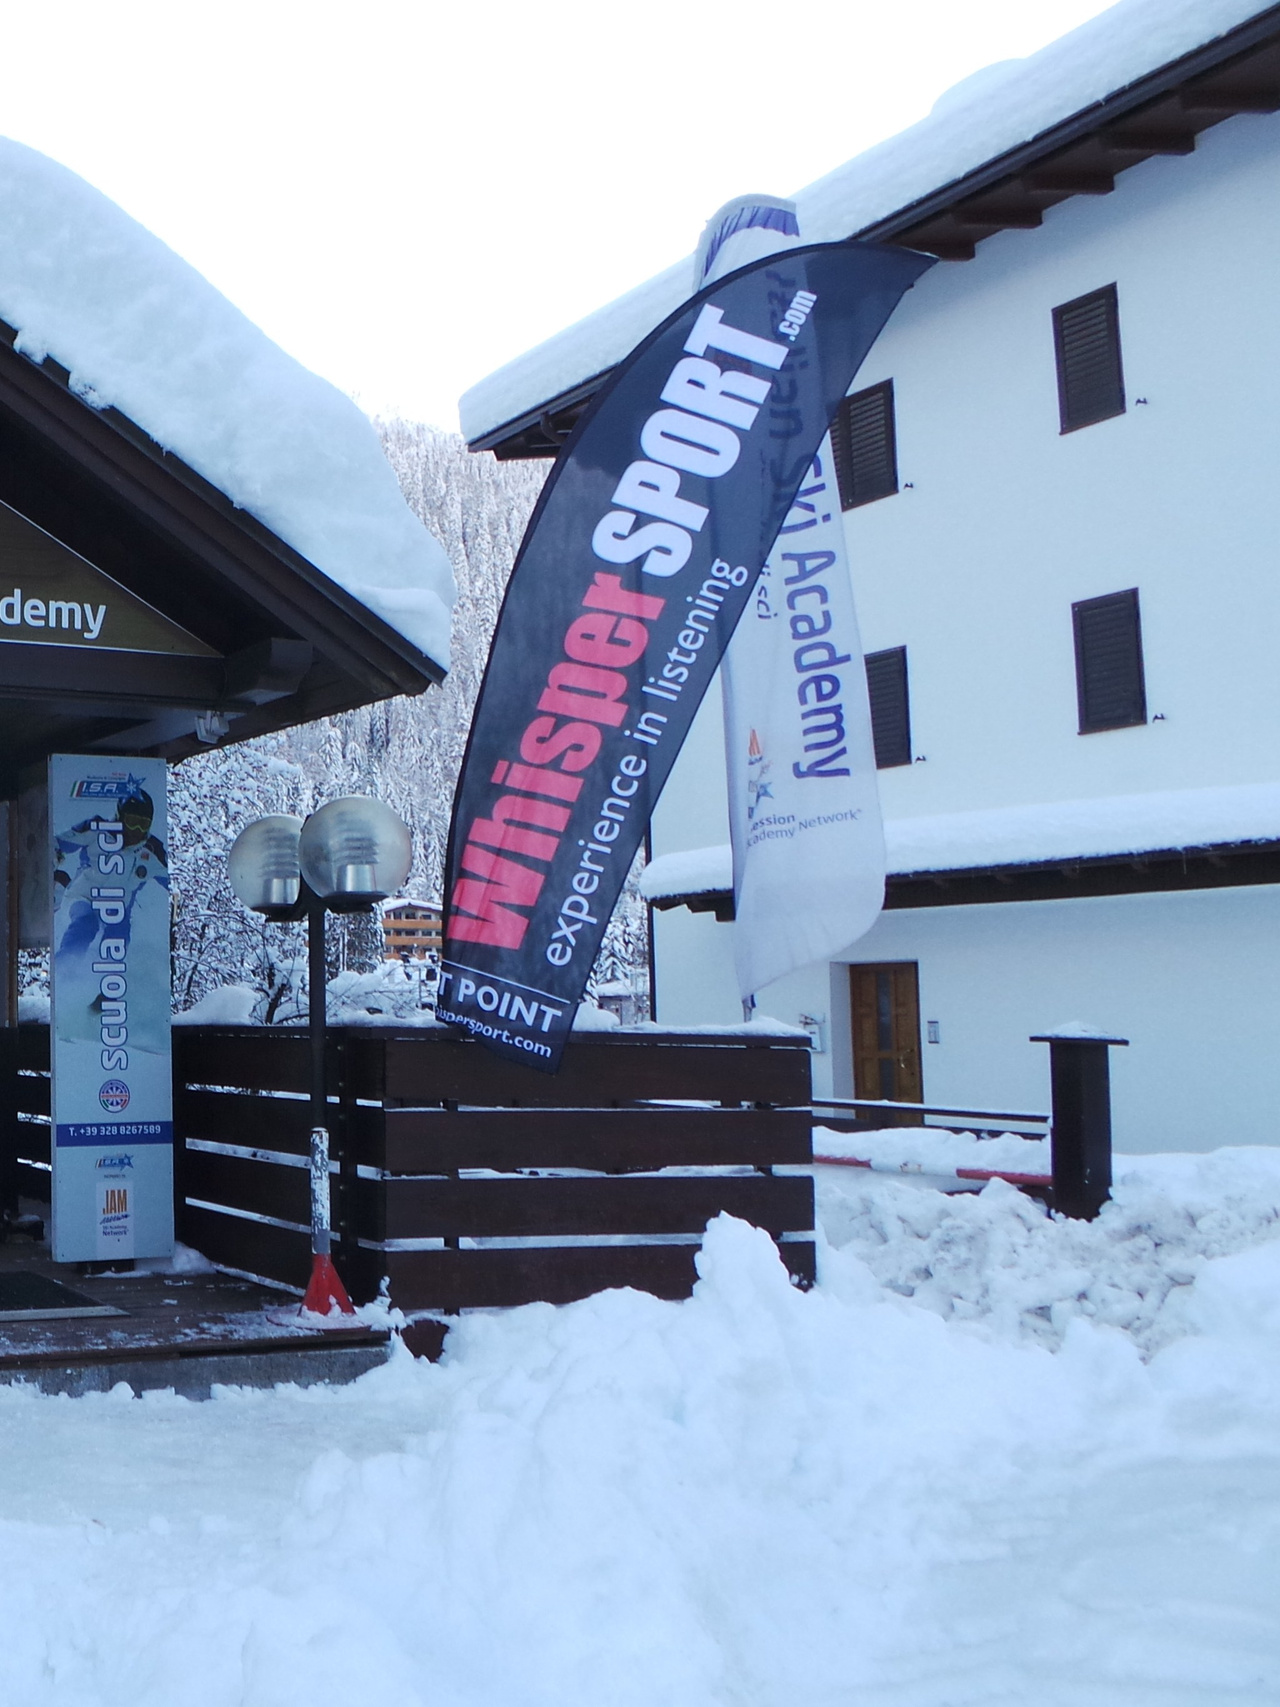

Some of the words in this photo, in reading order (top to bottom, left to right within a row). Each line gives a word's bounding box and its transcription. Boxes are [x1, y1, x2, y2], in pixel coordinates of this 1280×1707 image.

[757, 585, 778, 619] sci
[642, 557, 749, 701] listening
[781, 550, 851, 779] Academy
[624, 712, 668, 746] in
[799, 810, 858, 832] Network
[90, 821, 125, 876] sci
[545, 755, 647, 966] experience
[90, 888, 125, 925] di
[92, 937, 129, 1072] scuola
[458, 977, 563, 1033] POINT
[69, 1127, 78, 1136] T.
[80, 1126, 97, 1136] +39
[100, 1126, 117, 1136] 328
[120, 1125, 161, 1135] 8267589
[102, 1189, 127, 1215] JAM
